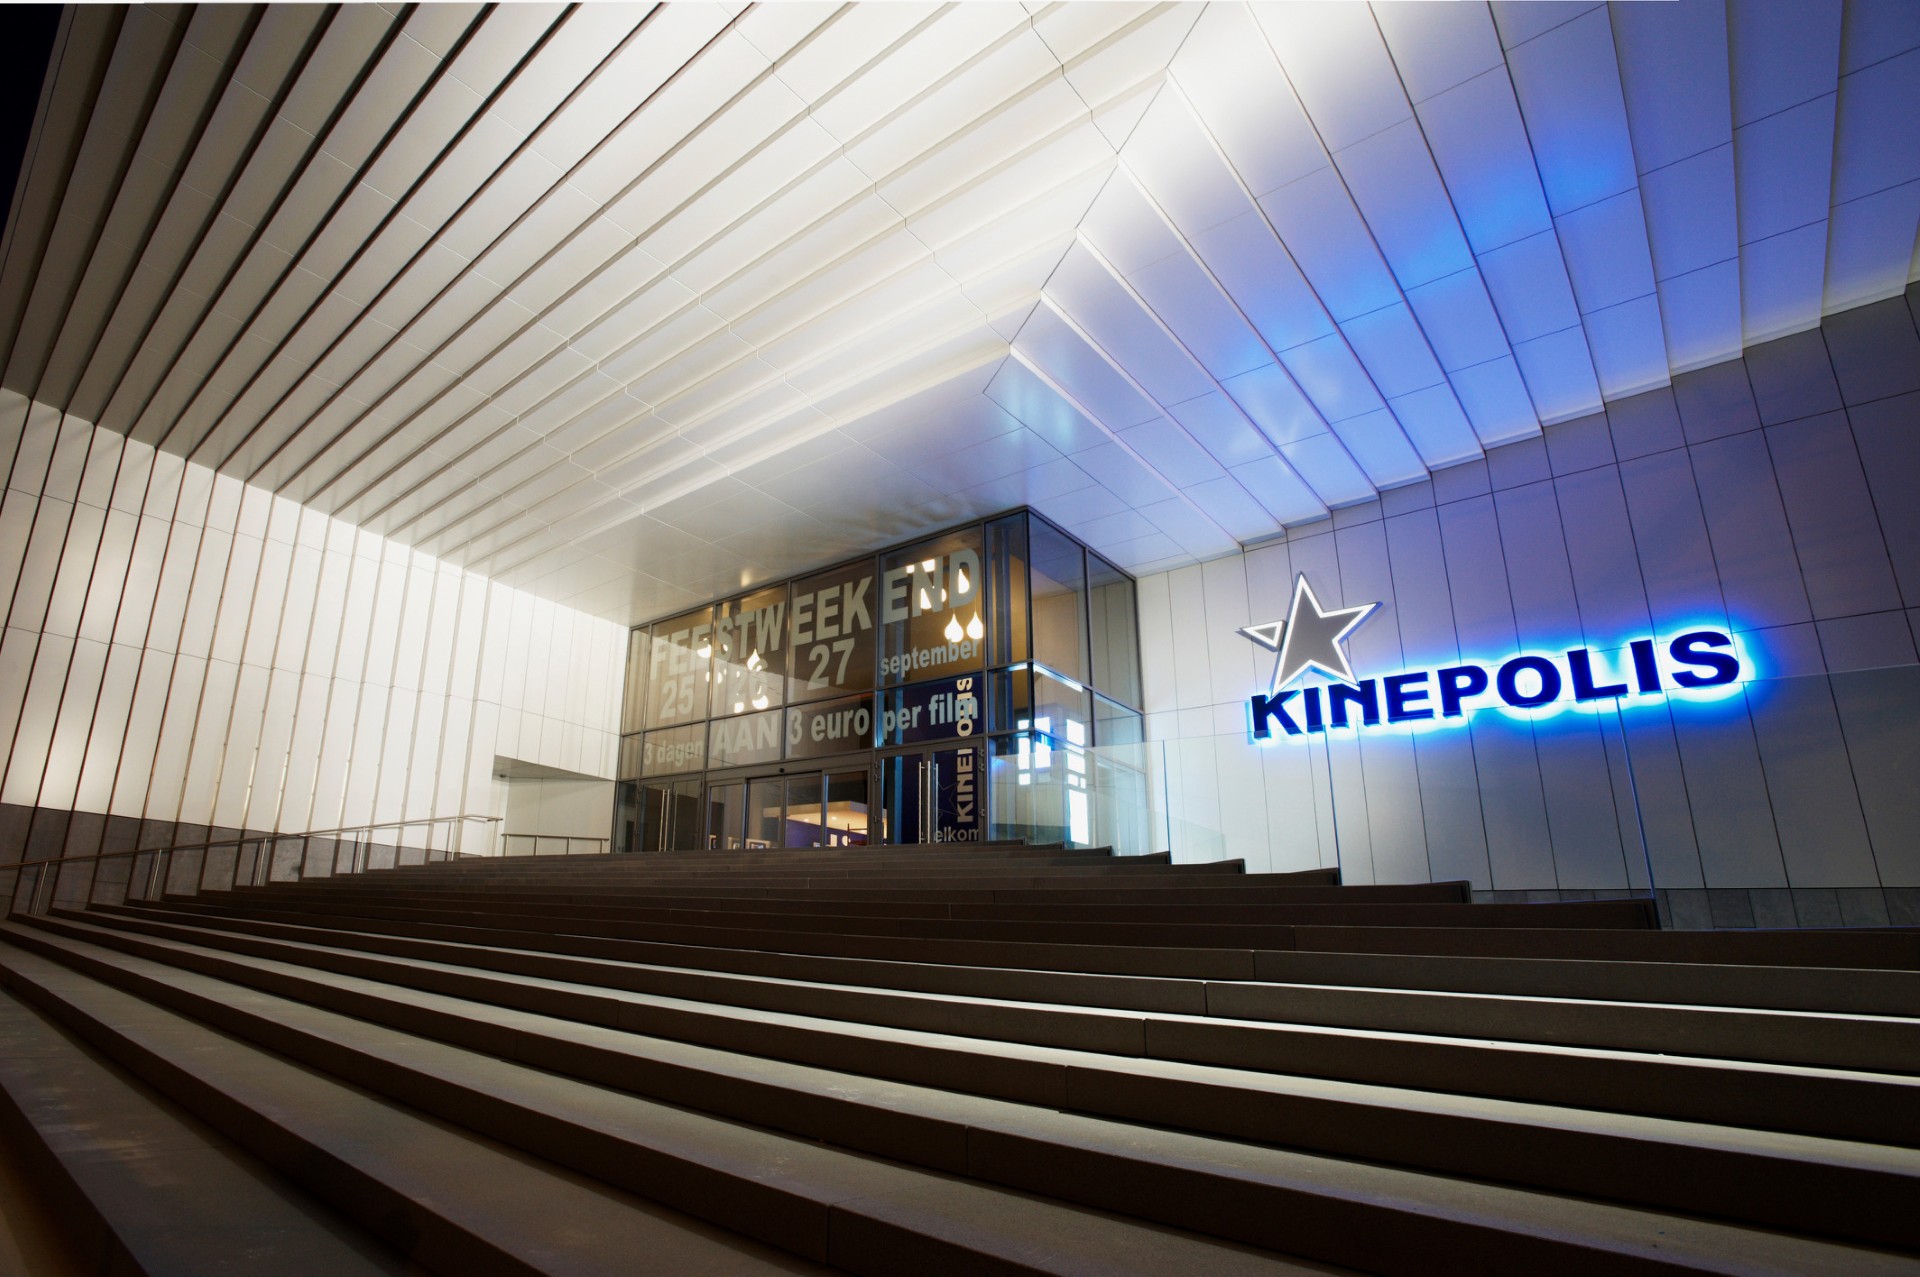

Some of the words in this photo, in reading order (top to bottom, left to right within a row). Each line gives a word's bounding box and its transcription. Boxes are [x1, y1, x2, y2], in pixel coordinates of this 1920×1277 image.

[660, 675, 695, 719] 25
[807, 637, 855, 691] 27
[880, 637, 979, 678] september
[1250, 630, 1741, 739] KINEPOLIS
[643, 742, 653, 766] 3
[656, 739, 703, 768] dagen
[711, 714, 779, 757] AAN
[788, 707, 803, 745] 3
[811, 707, 870, 741] euro
[883, 703, 922, 740] per
[929, 692, 979, 726] film
